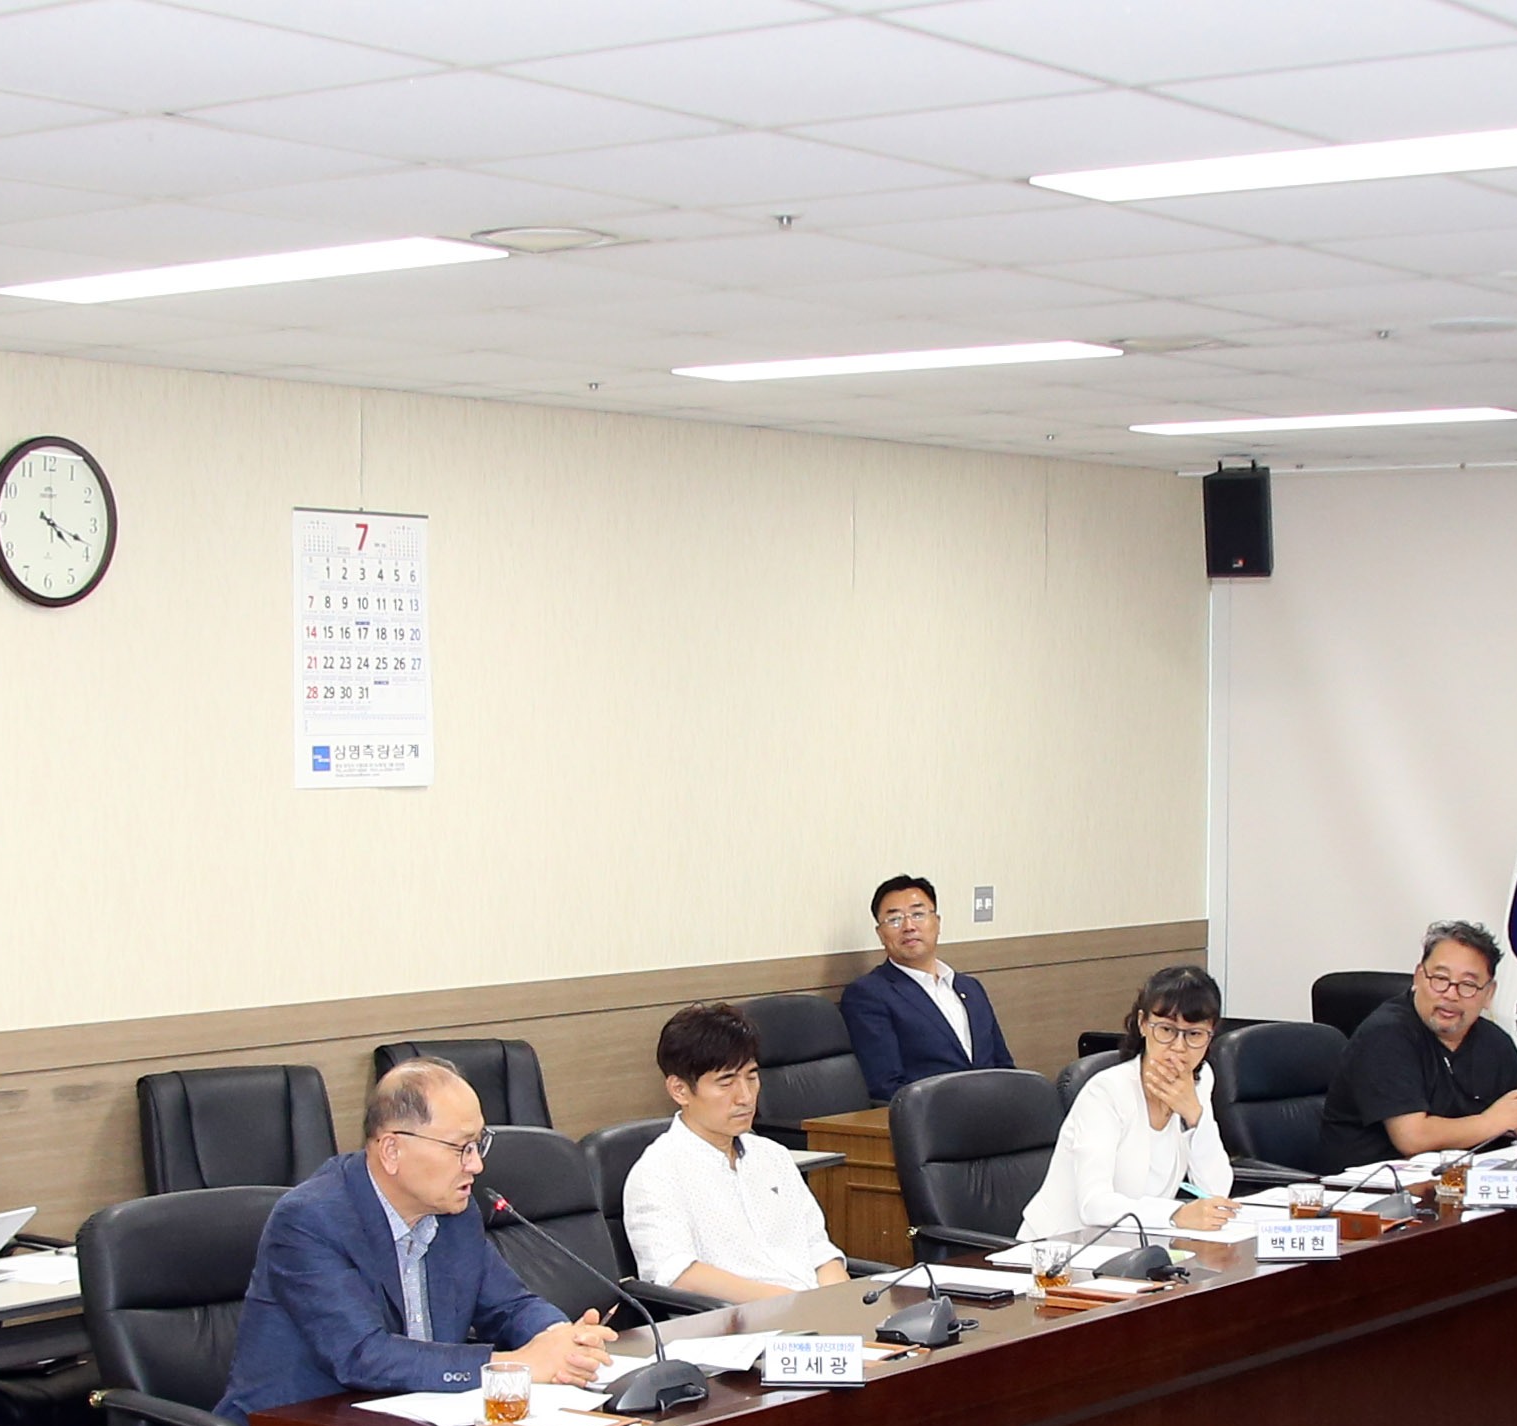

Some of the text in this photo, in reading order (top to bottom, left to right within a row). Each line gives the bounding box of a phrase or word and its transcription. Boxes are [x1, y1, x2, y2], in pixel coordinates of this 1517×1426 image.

[21, 461, 33, 478] 11
[43, 455, 57, 472] 12
[4, 482, 18, 499] 10
[84, 487, 92, 504] 2
[0, 510, 7, 527] 9
[89, 517, 98, 534] 3
[355, 523, 368, 551] 7
[5, 542, 14, 558] 8
[82, 546, 90, 562] 4
[23, 565, 30, 582] 7
[44, 573, 52, 590] 6
[67, 568, 75, 585] 5
[357, 597, 369, 610] 10
[376, 598, 386, 610] 11
[393, 598, 404, 611] 12
[410, 599, 419, 611] 13
[306, 626, 421, 641] 14 15 16 17 18 19 20
[307, 656, 422, 670] 21 22 23 24 25 26 27
[306, 686, 369, 699] 28 29 30 31
[1270, 1235, 1325, 1252] 백태현
[781, 1356, 848, 1375] 임세광
